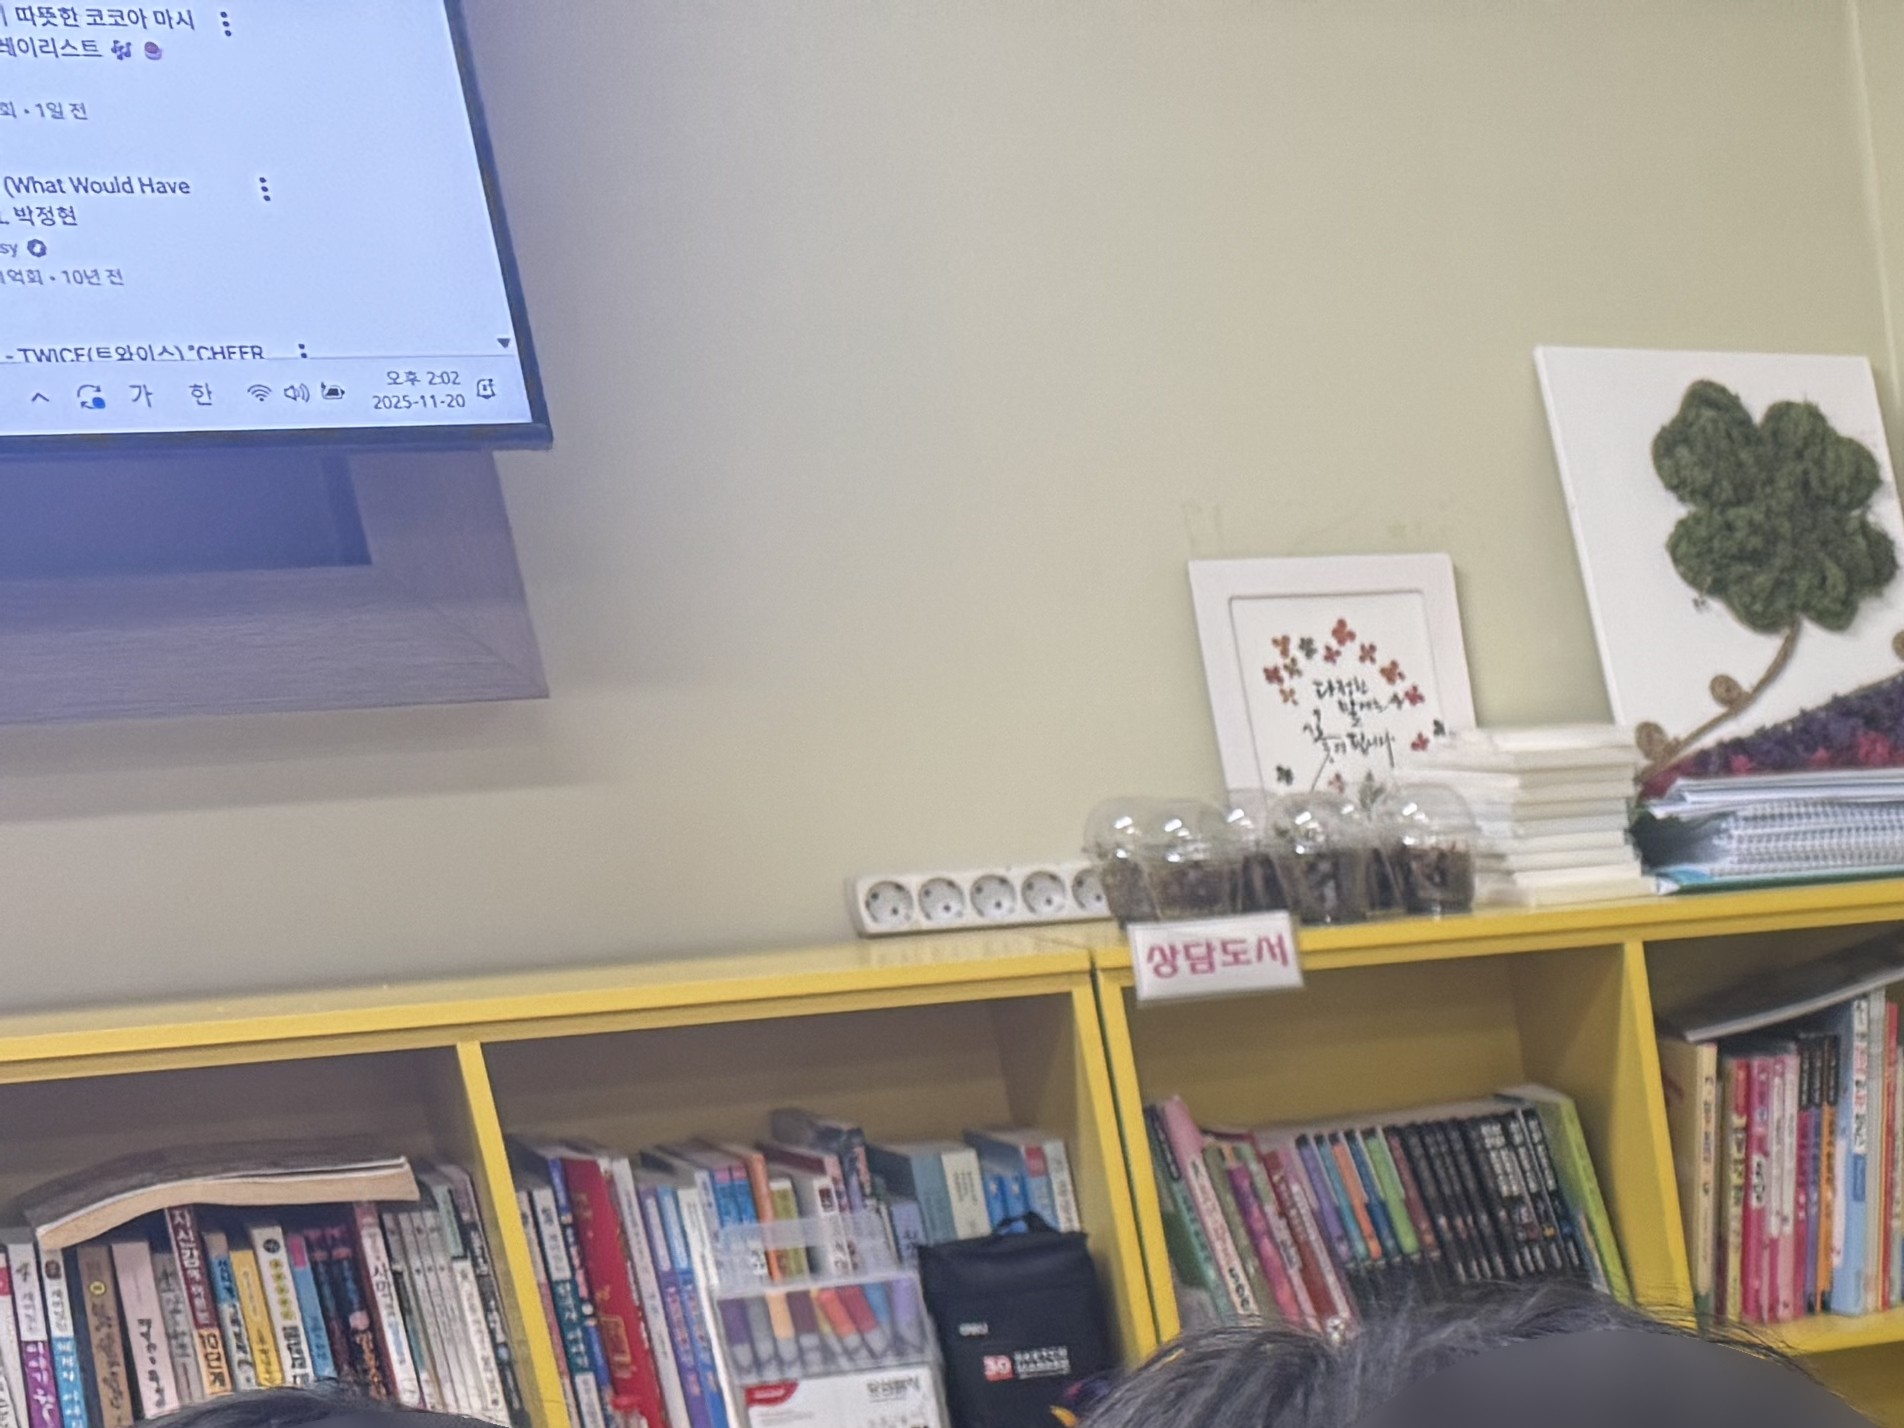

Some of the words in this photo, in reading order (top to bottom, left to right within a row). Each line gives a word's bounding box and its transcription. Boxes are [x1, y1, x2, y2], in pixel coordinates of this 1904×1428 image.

[15, 6, 80, 28] 따뜻한
[86, 8, 148, 30] 코코아
[153, 9, 195, 30] 마시
[69, 103, 88, 120] 전
[4, 176, 66, 198] (What
[68, 176, 135, 194] Would
[138, 177, 191, 194] Have
[13, 205, 78, 226] 박정현
[105, 268, 125, 286] 전
[426, 371, 461, 386] 2:02
[372, 394, 466, 410] 2025-11-20
[1147, 933, 1289, 979] 상담도서
